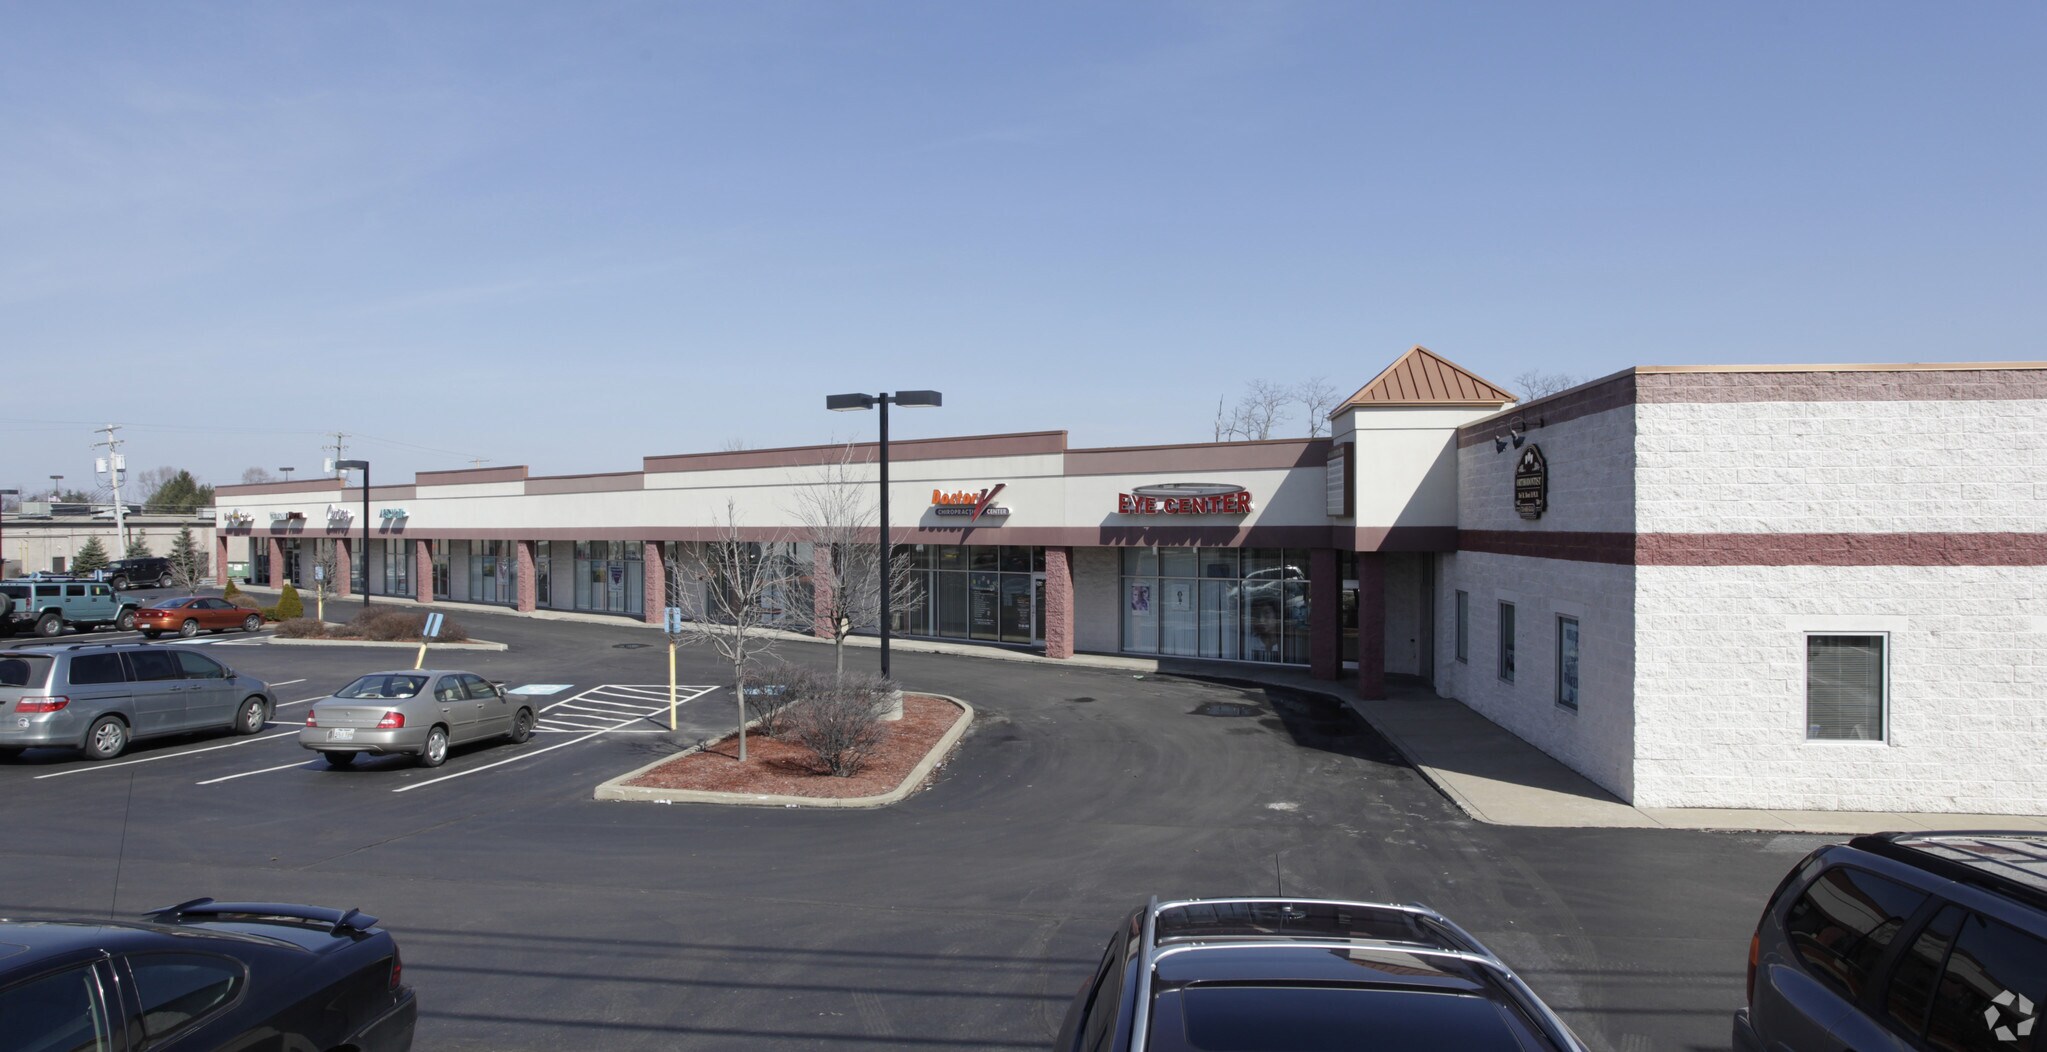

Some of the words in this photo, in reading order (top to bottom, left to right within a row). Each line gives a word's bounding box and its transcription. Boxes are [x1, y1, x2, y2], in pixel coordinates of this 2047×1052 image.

[931, 489, 978, 505] Doctor
[1118, 492, 1158, 514] EYE
[1163, 491, 1252, 514] CENTER
[937, 508, 978, 516] CHIROPRACTI
[986, 508, 1008, 516] CENTER
